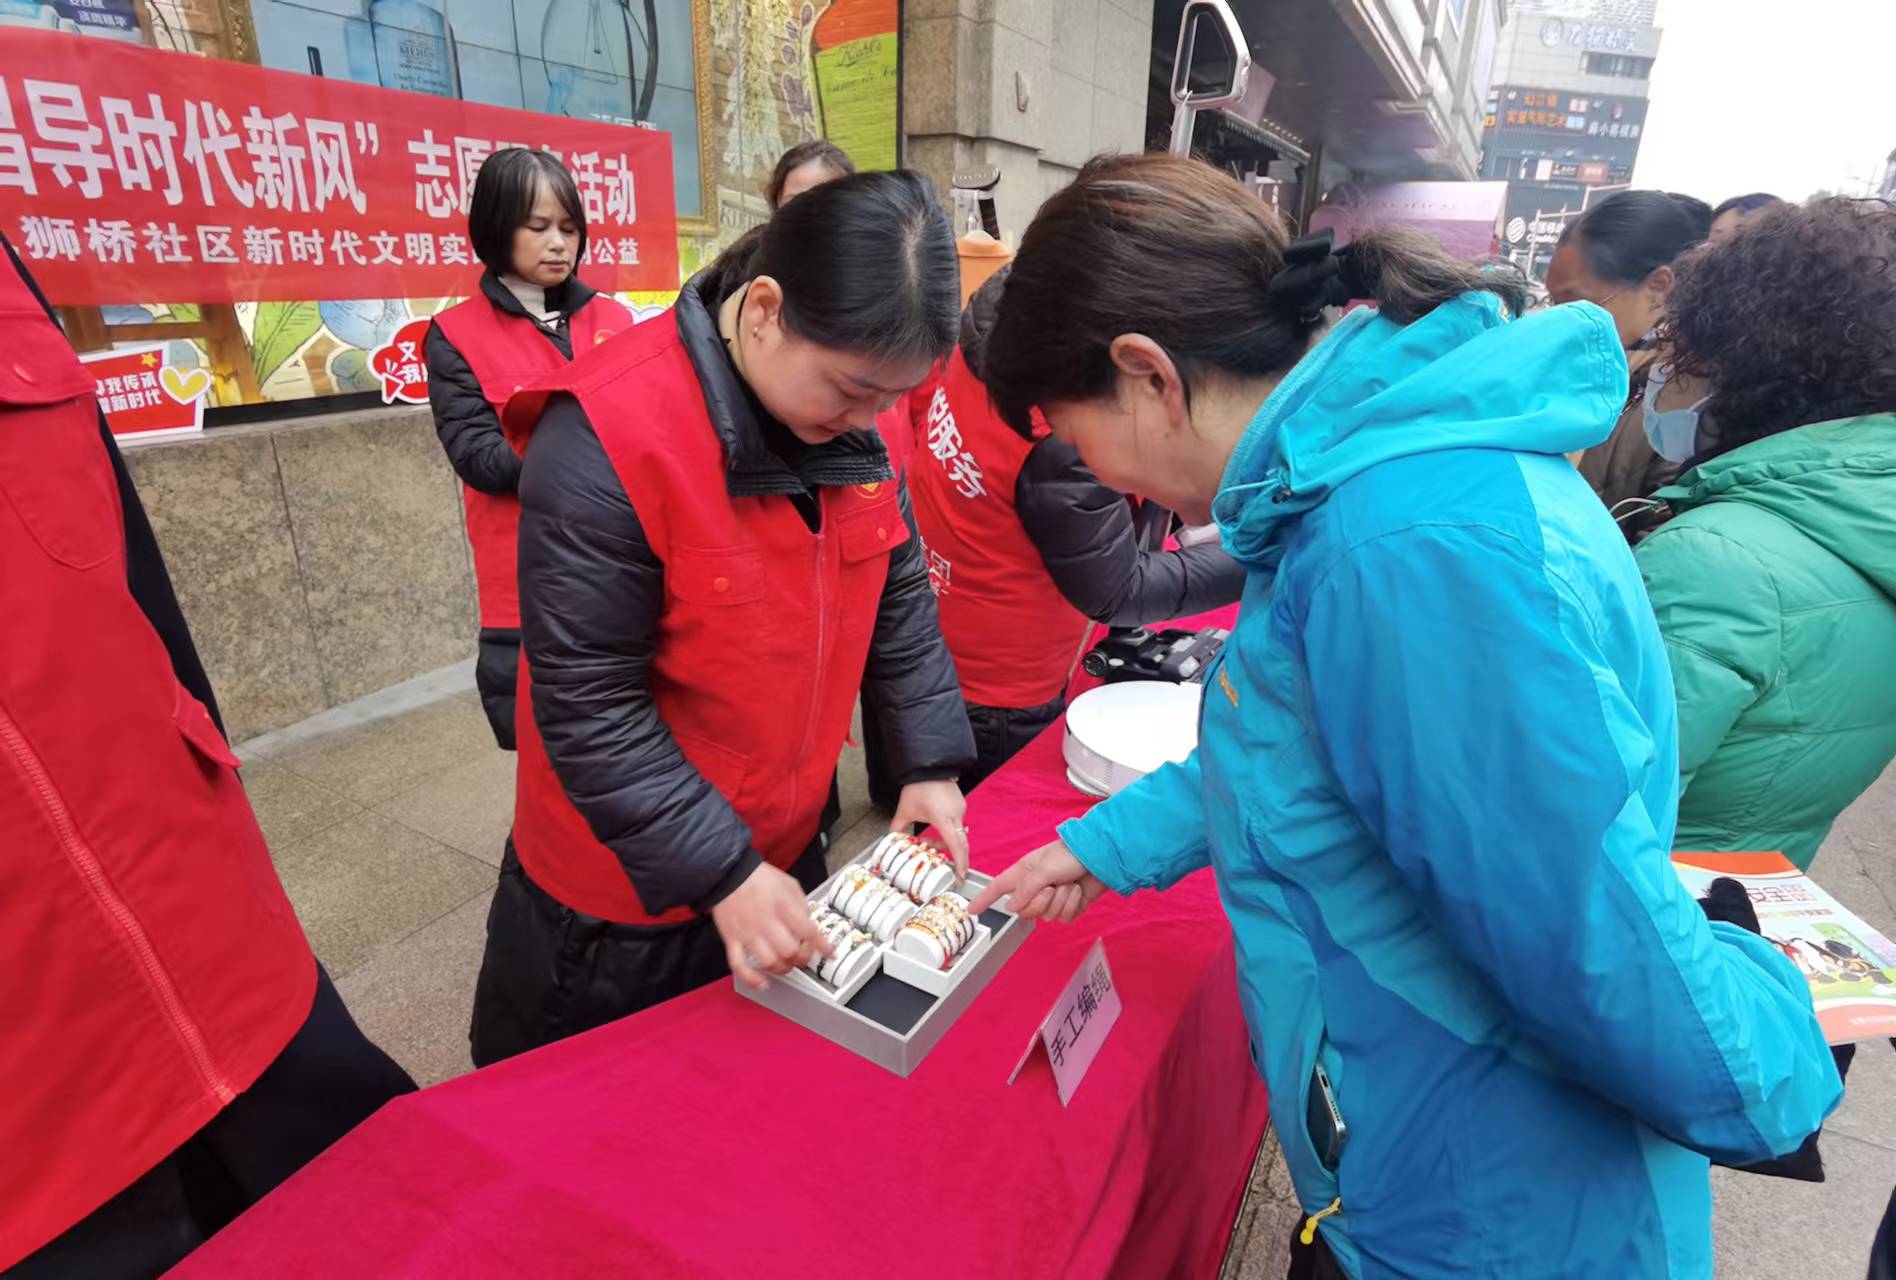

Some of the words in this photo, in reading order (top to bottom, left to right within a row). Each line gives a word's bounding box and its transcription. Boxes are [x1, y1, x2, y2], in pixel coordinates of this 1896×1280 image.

[408, 129, 637, 226] 志愿活动
[1050, 961, 1111, 1067] 手工编绳
